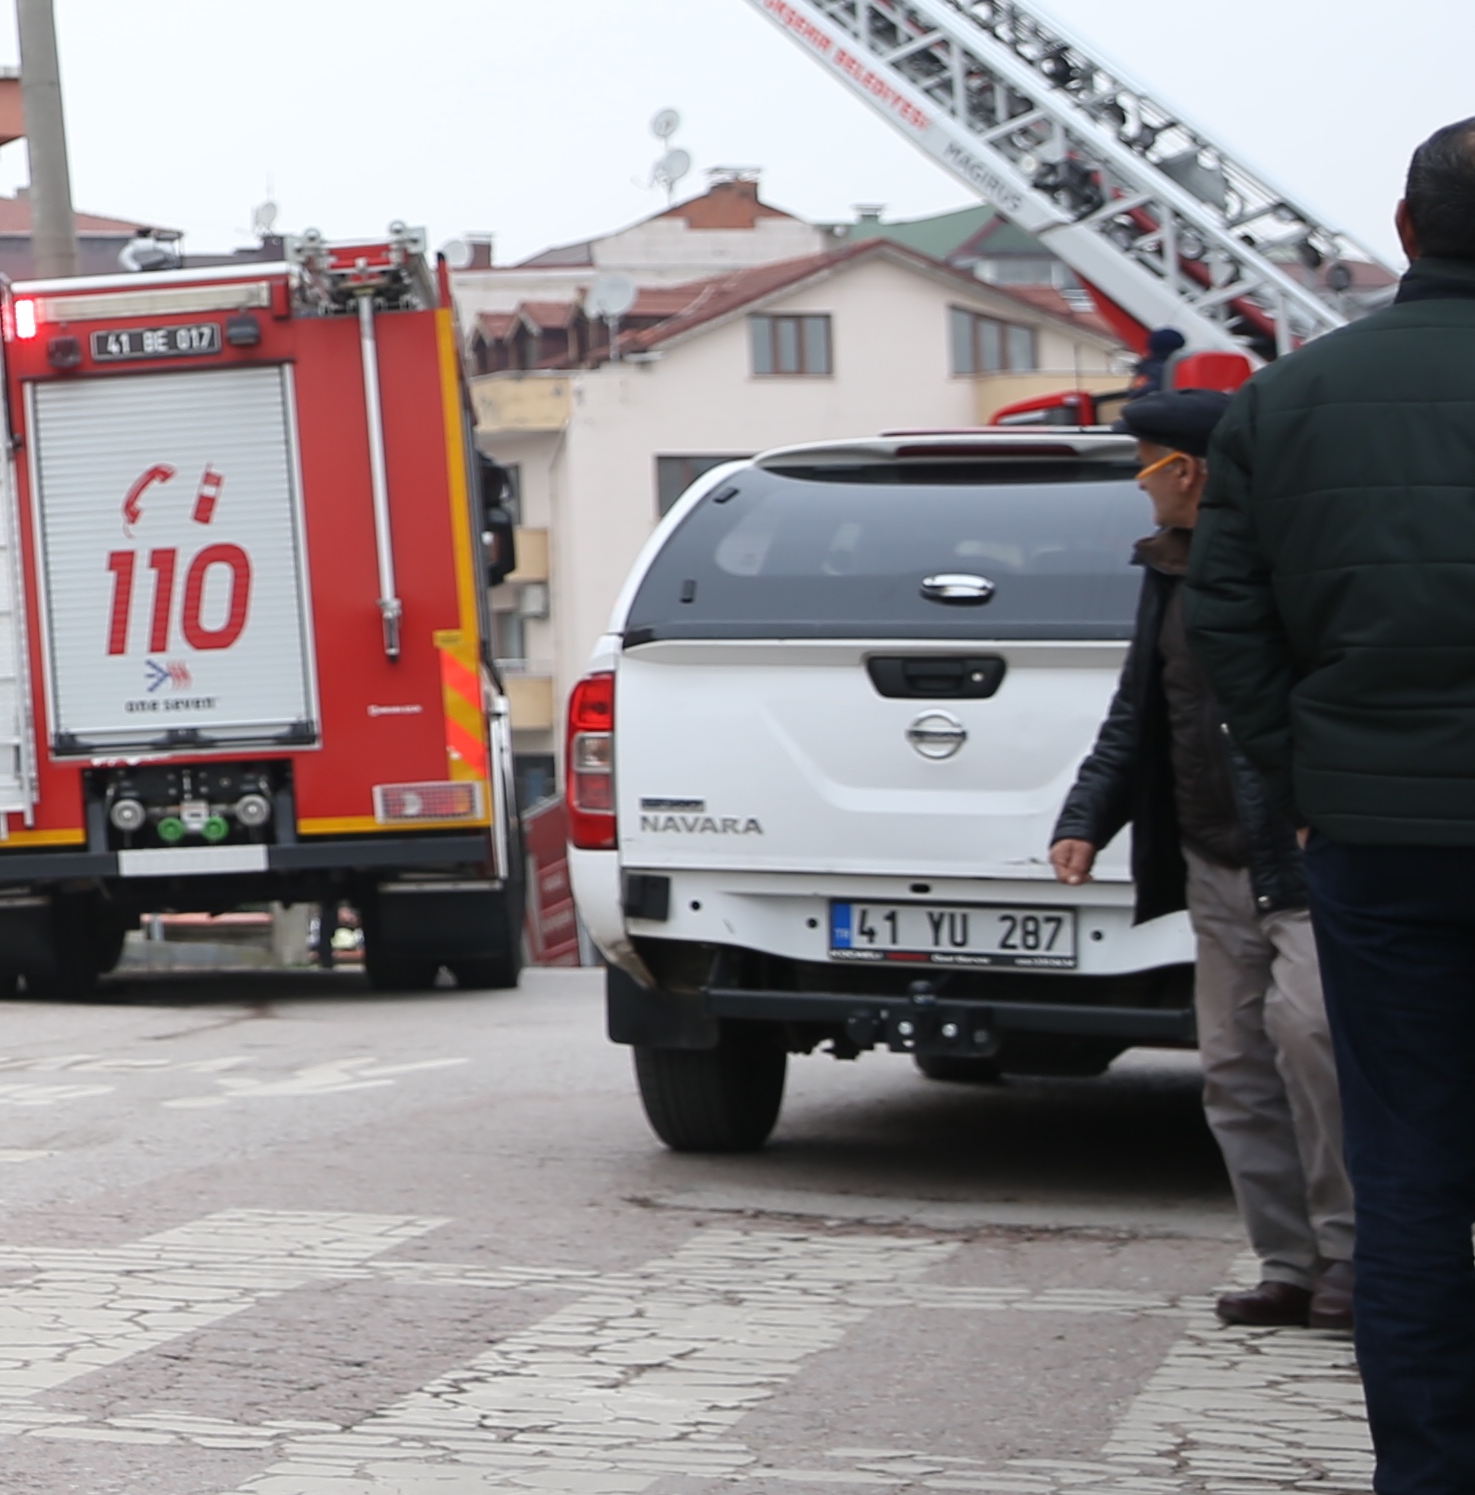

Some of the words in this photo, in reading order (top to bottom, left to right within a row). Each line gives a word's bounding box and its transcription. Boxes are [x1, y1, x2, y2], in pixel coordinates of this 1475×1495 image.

[945, 140, 1022, 212] MAGIRUS
[107, 332, 130, 355] 41
[106, 541, 251, 655] 110
[640, 815, 764, 835] NAVARA
[859, 909, 898, 945] 41
[926, 911, 968, 947] YU
[999, 914, 1064, 951] 287
